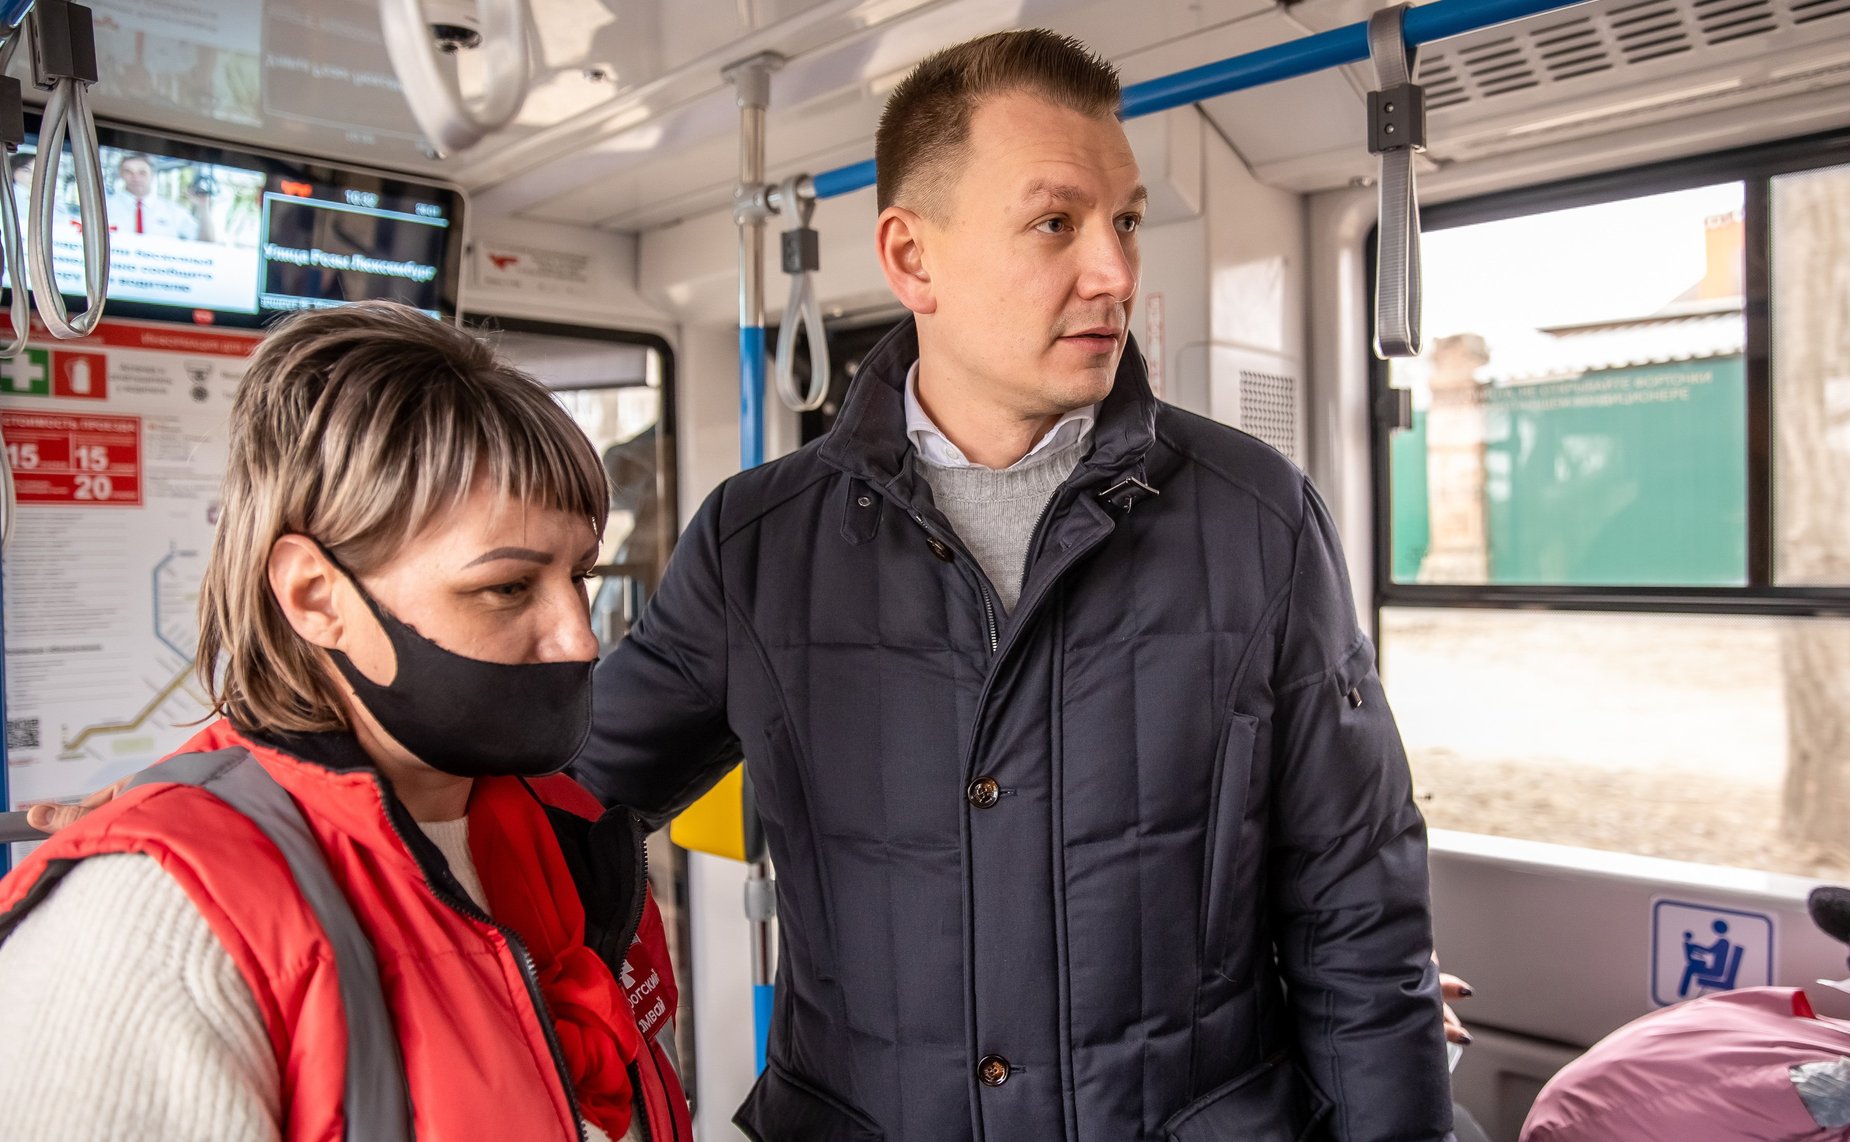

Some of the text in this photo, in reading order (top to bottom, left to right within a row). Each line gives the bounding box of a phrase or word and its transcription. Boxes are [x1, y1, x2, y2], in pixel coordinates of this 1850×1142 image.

[7, 443, 40, 469] 15
[75, 445, 109, 472] 15
[73, 475, 113, 500] 20
